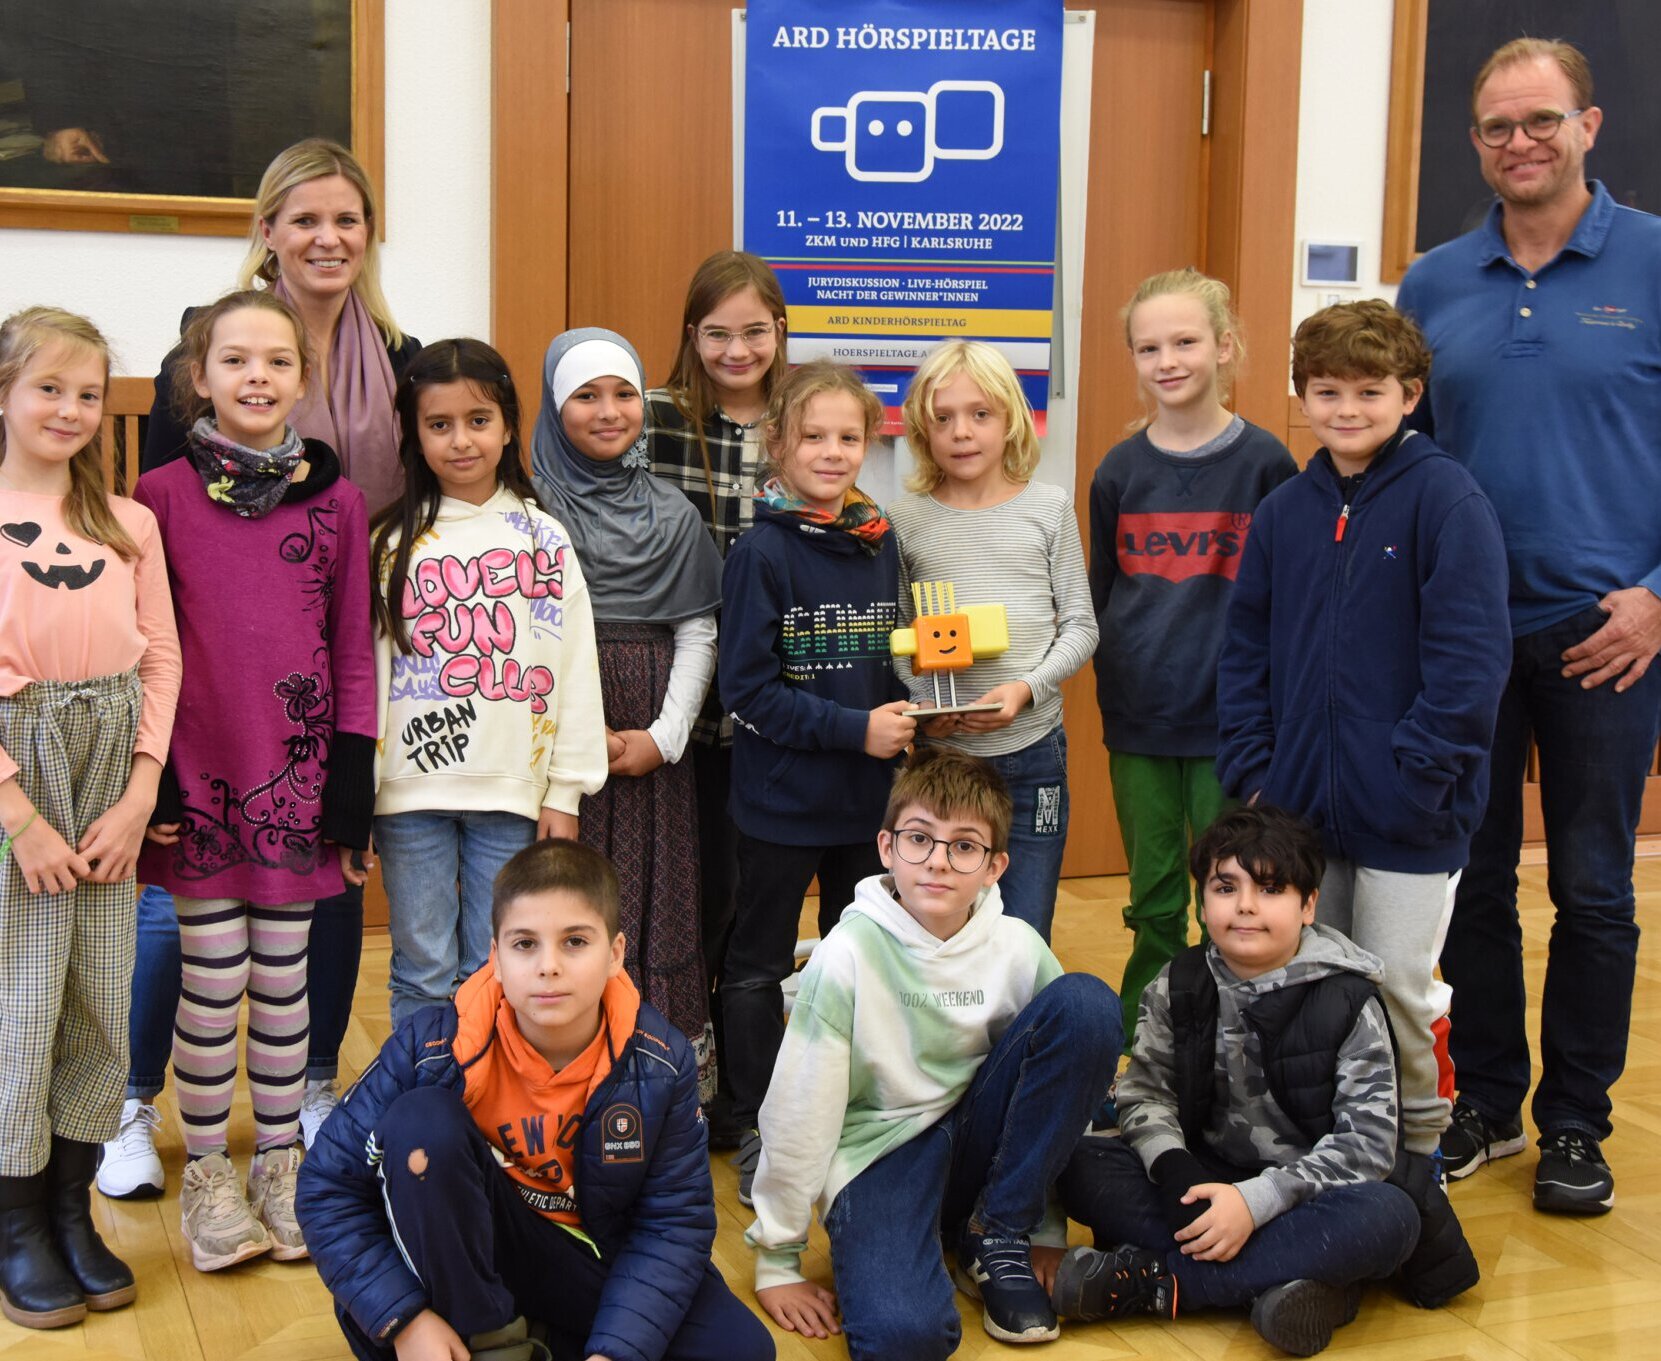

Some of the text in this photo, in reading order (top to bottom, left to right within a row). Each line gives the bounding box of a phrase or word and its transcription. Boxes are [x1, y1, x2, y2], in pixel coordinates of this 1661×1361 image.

[773, 23, 1036, 52] ARD HÖRSPIELTAGE
[776, 210, 802, 227] 11.
[825, 211, 852, 228] 13.
[857, 211, 973, 230] NOVEMBER
[978, 213, 1024, 231] 2022
[805, 235, 836, 247] ZKM
[872, 235, 900, 248] HFG
[911, 237, 992, 250] KARLSRUHE
[808, 277, 900, 289] JURYDISKUSSION
[907, 278, 988, 290] LIVE-HÖRSPIEL
[816, 290, 854, 300] NACHT
[856, 290, 878, 301] DER
[827, 315, 967, 327] ARD KINDERHÖRSPIELTAG
[833, 348, 929, 358] HOERSPIELTAGE.A
[1124, 529, 1240, 557] Levi's
[401, 548, 564, 619] LOVELY
[411, 601, 516, 657] FUN
[439, 654, 554, 714] CLUB
[401, 698, 477, 746] URBAN
[898, 988, 985, 1009] 100% WEEKEND
[496, 1114, 545, 1159] EW
